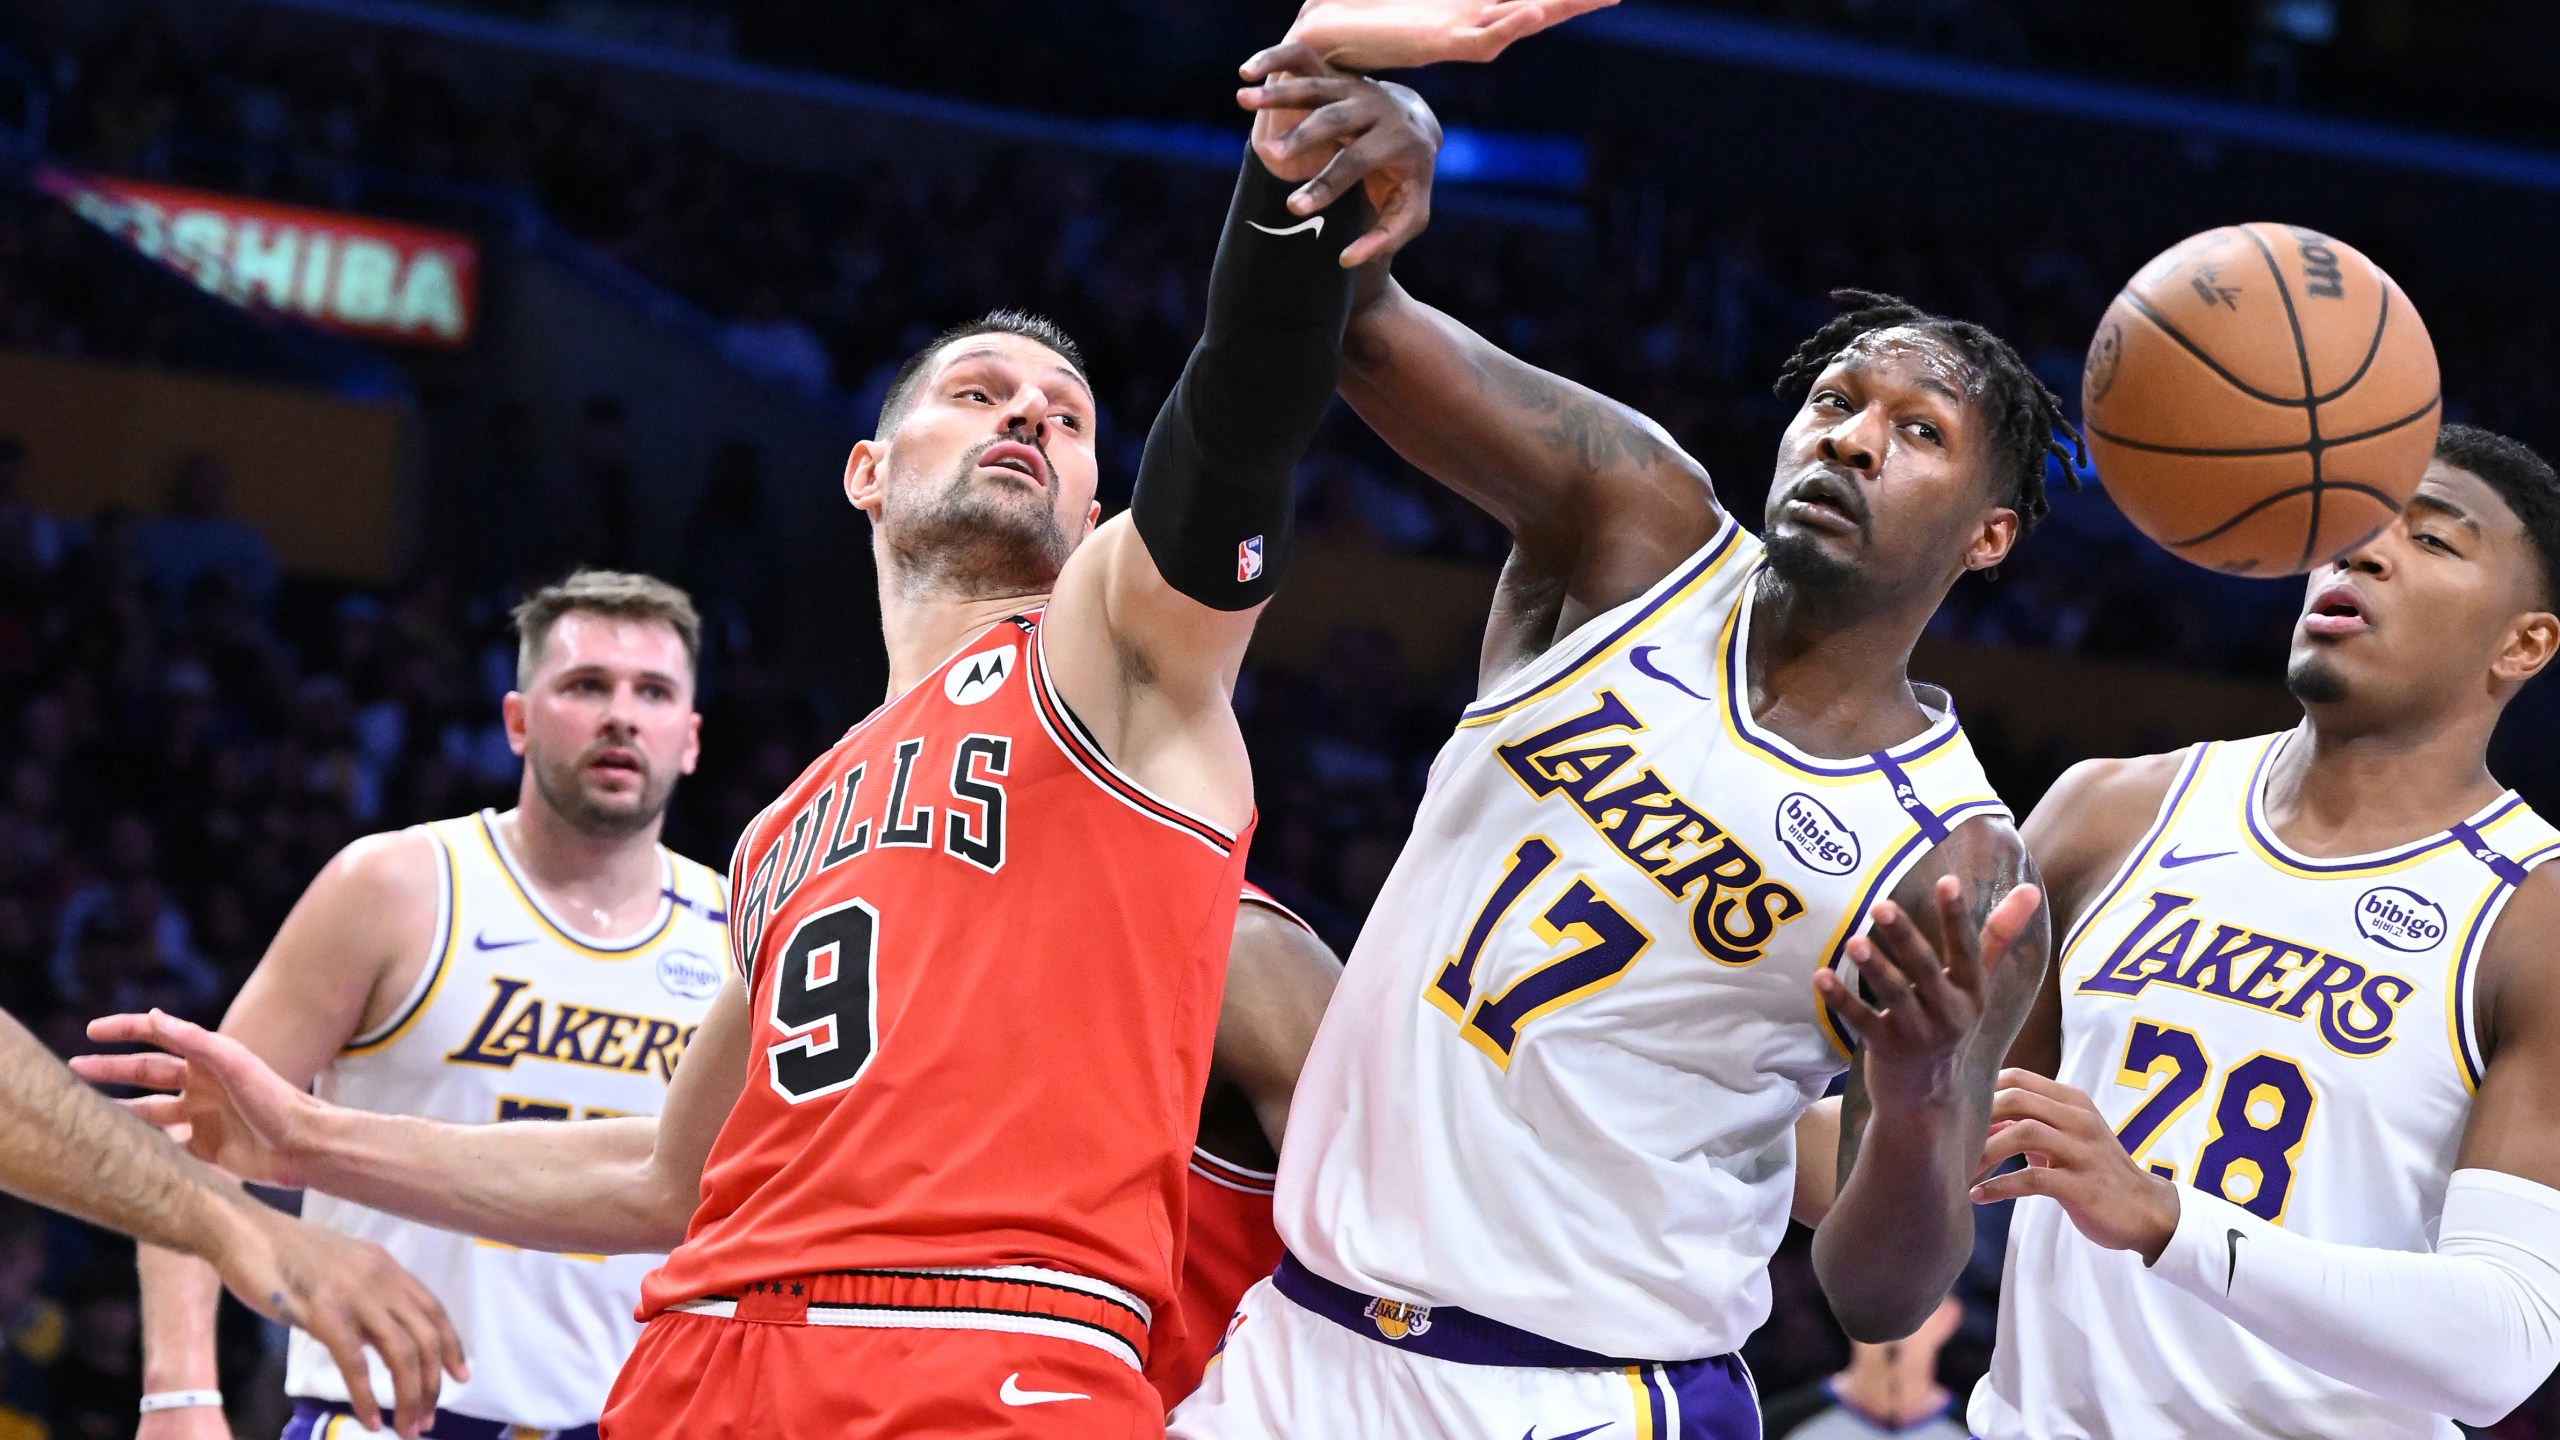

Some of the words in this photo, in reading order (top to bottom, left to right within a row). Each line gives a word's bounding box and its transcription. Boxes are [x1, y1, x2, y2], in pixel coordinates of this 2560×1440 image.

[741, 732, 1012, 1004] BULLS
[1493, 686, 1808, 968] LAKERS
[1786, 798, 1853, 867] bibigo
[2364, 894, 2441, 939] bibigo
[767, 896, 880, 1105] 9
[1422, 832, 1656, 1075] 17
[2074, 888, 2421, 1060] LAKERS
[2113, 1016, 2319, 1228] 28
